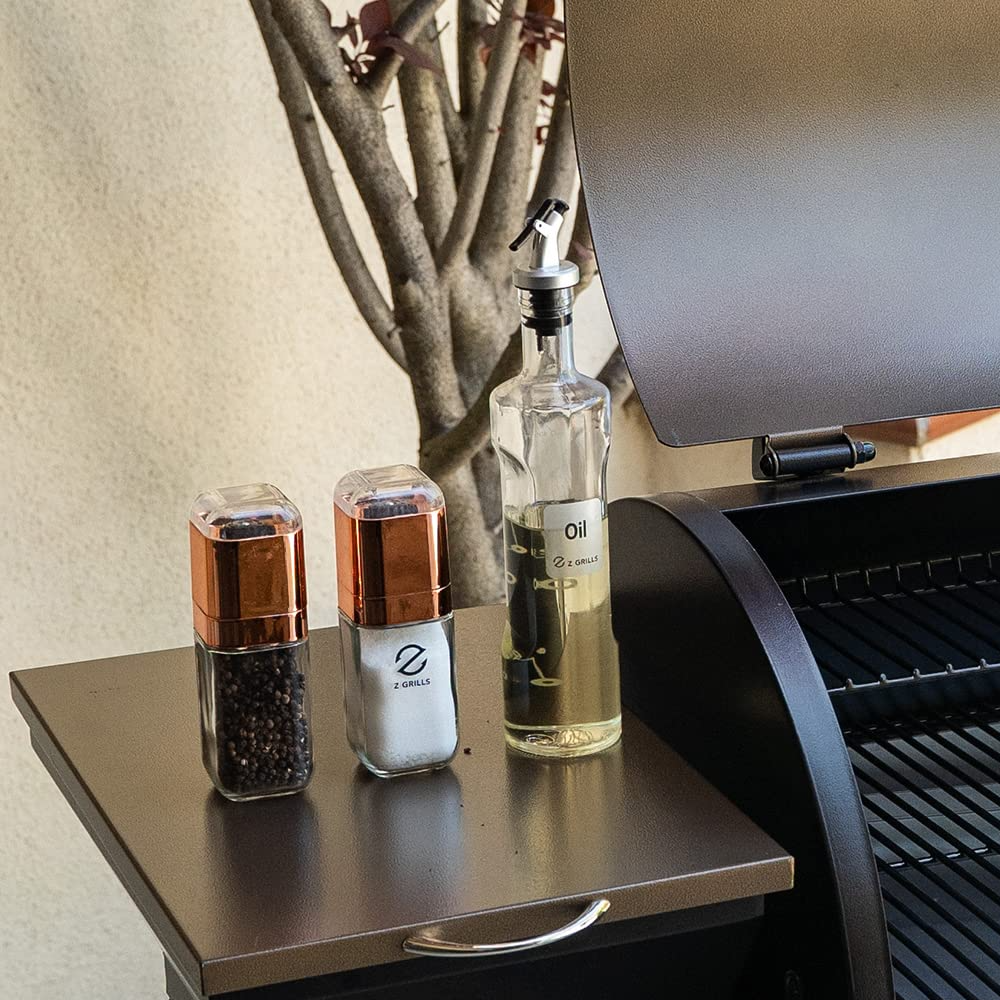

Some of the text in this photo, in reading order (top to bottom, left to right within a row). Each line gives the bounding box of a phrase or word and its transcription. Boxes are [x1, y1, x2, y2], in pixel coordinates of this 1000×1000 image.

[564, 519, 587, 541] Oil
[574, 554, 599, 566] GRILLS
[401, 677, 431, 689] GRILLS
